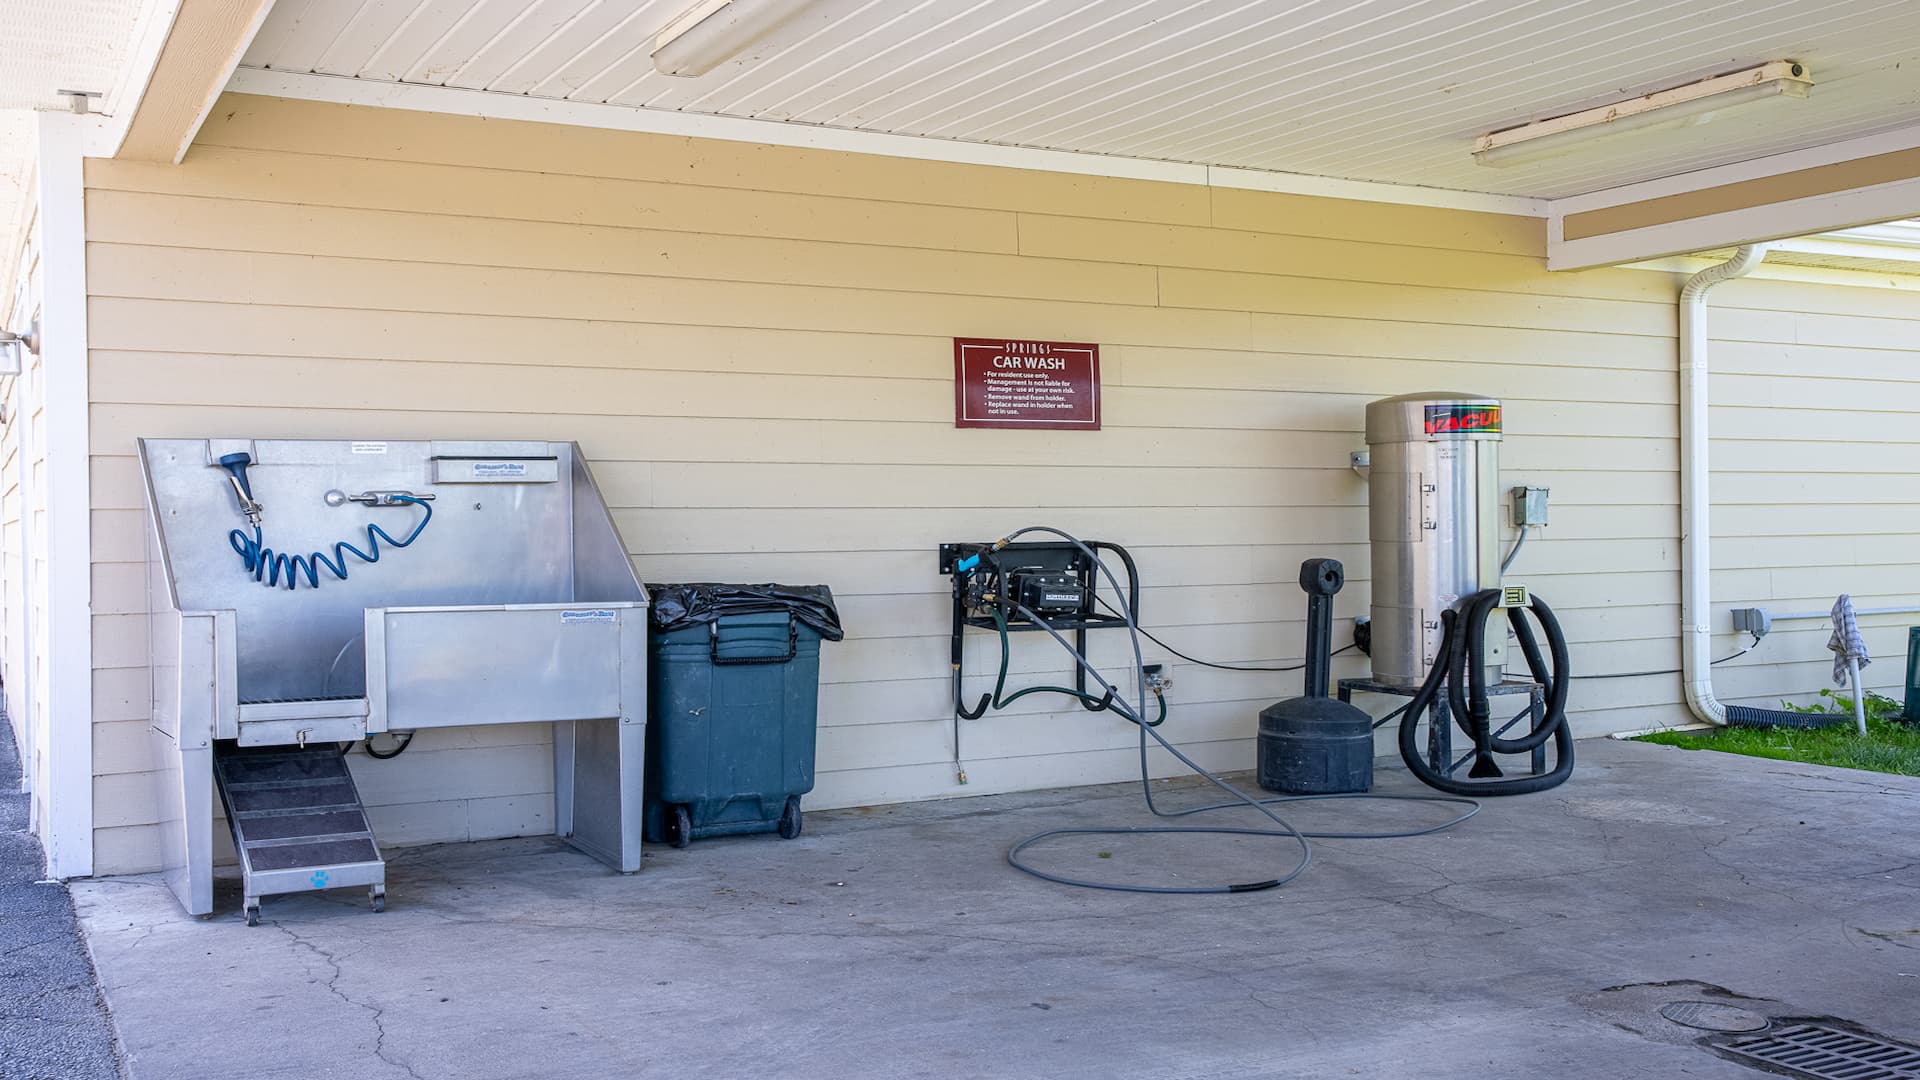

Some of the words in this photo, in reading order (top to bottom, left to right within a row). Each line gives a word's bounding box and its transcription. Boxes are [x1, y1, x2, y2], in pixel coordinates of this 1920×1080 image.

[1006, 342, 1050, 354] SPRINGS
[993, 356, 1022, 368] CAR
[1024, 357, 1065, 369] WASH
[987, 385, 1012, 394] damage
